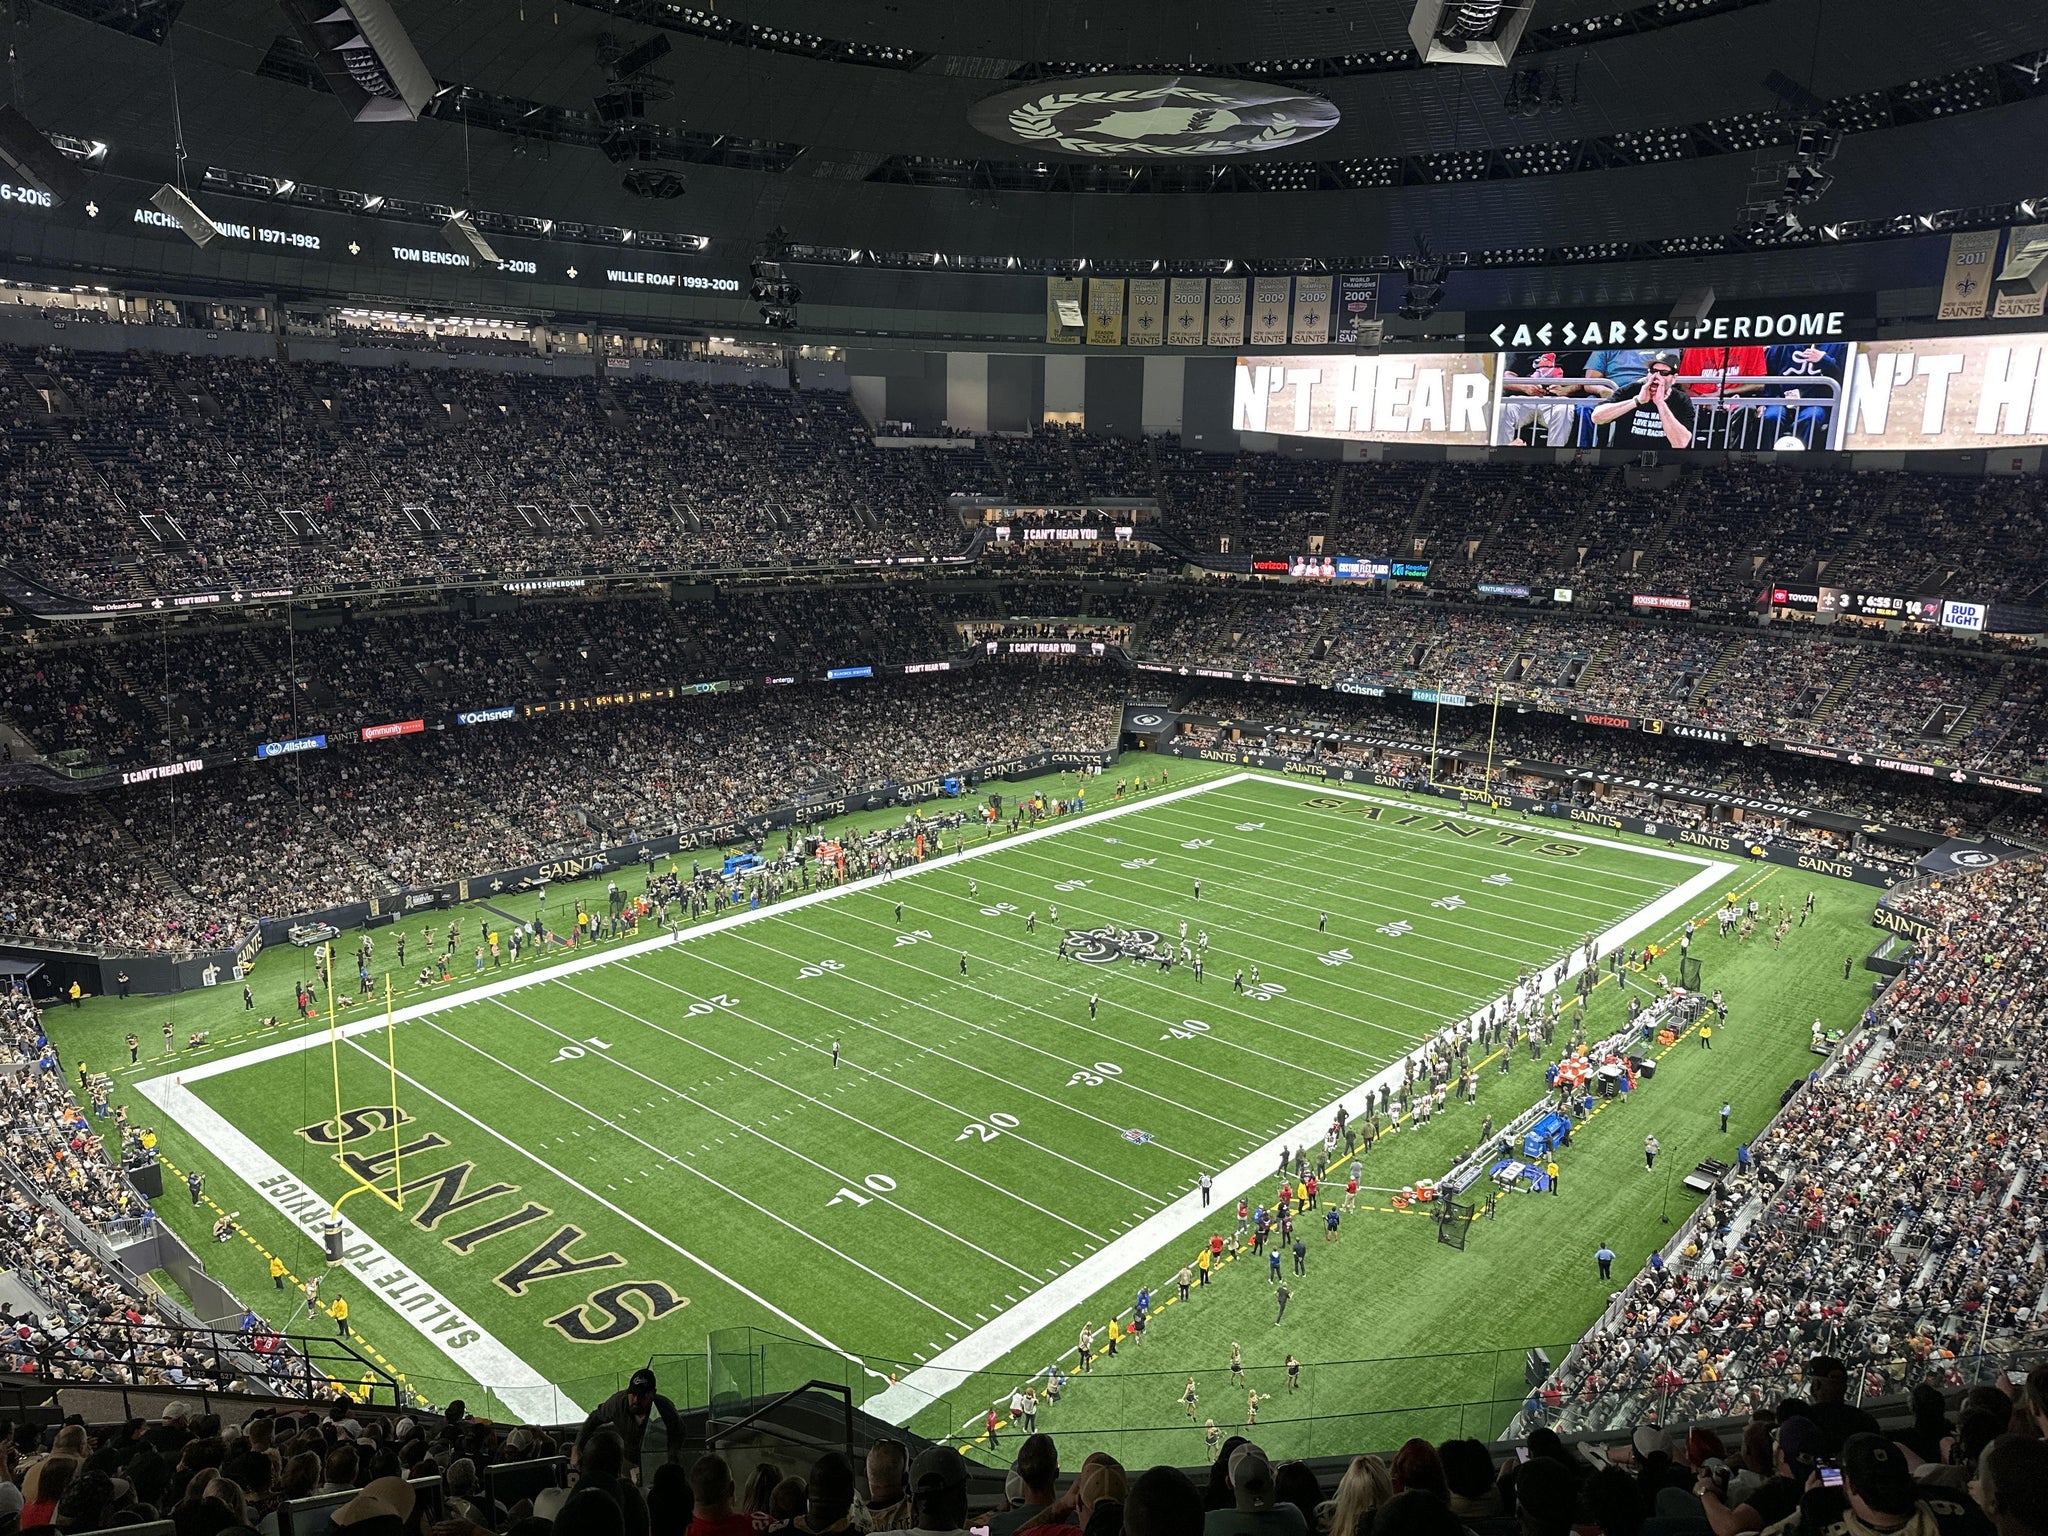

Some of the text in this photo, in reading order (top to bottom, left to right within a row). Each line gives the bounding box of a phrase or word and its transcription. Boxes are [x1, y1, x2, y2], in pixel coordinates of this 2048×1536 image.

[134, 209, 183, 229] ARCHI
[258, 229, 320, 250] 1971-1982
[392, 247, 420, 263] TOM
[422, 251, 470, 267] BENSON
[1957, 252, 1986, 265] 2011
[607, 270, 739, 291] WILLIE ROAF 1993-2001
[1135, 295, 1158, 305] 1991
[1174, 294, 1201, 304] 2000
[1214, 294, 1241, 304] 2006
[1258, 293, 1285, 303] 2009
[1300, 292, 1327, 302] 2009
[1942, 307, 1982, 317] SAINTS
[1997, 304, 2040, 315] SAINTS
[1253, 335, 1284, 344] SAINTS
[1294, 335, 1325, 343] SAINTS
[1489, 319, 1649, 347] CAESARS
[1130, 336, 1160, 345] SAINTS
[1169, 336, 1201, 345] SAINTS
[1210, 336, 1241, 345] SAINTS
[1334, 363, 1490, 432] HEAR
[1023, 529, 1098, 540] I CAN'T HEAR YOU
[1254, 560, 1288, 570] verizon
[435, 576, 464, 584] SAINTS
[497, 572, 525, 580] SAINTS
[302, 584, 334, 594] SAINTS
[370, 580, 401, 589] SAINTS
[1478, 585, 1529, 596] VENTURE GLOBAL
[1633, 595, 1690, 608] ROUSES MARKETS
[1788, 593, 1818, 603] TOYOTA
[1839, 594, 1849, 607] 3
[1866, 595, 1891, 608] 6:55
[92, 604, 105, 612] New
[106, 603, 126, 611] Orleans
[1905, 601, 1922, 615] 14
[1951, 605, 1976, 616] BUD
[1945, 614, 1980, 626] LIGHT
[1015, 643, 1038, 653] CAN'T
[1038, 643, 1059, 653] HEAR
[1060, 643, 1076, 653] YOU
[696, 682, 717, 692] COX
[1308, 677, 1332, 686] SAINTS
[1341, 682, 1384, 697] Ochsner
[1441, 694, 1465, 705] HEALTH
[466, 708, 513, 724] Ochsner
[1536, 704, 1564, 714] SAINTS
[1584, 714, 1629, 728] verizon
[328, 731, 358, 743] SAINTS
[365, 724, 402, 739] Community
[1673, 725, 1727, 742] CAESARS
[1737, 733, 1768, 744] SAINTS
[282, 739, 317, 753] Allstate
[1263, 725, 1463, 757] CAESARS SUPERDOME
[1200, 750, 1237, 762] SAINTS
[1784, 743, 1837, 758] New Orleans Saints
[122, 759, 203, 784] I CAN'T HEAR YOU
[1285, 761, 1323, 775] SAINTS
[1881, 760, 1900, 769] CAN'T
[1978, 776, 2042, 793] New Orleans Saints
[1469, 792, 1512, 807] SAINTS
[1564, 768, 1812, 818] CAESARS SUPERDOME
[1570, 808, 1616, 828] SAINTS
[1299, 798, 1588, 857] SAINTS
[1679, 831, 1730, 850] SAINTS
[1798, 855, 1853, 878] SAINTS
[1431, 895, 1466, 911] 20
[1376, 921, 1413, 937] 30
[901, 929, 933, 946] 40
[1317, 948, 1354, 967] 40
[810, 959, 846, 978] 30
[1246, 983, 1287, 1001] 50
[697, 993, 740, 1016] 20
[1170, 1019, 1211, 1041] 40
[558, 1036, 613, 1061] 10
[1071, 1061, 1123, 1086] 30
[962, 1112, 1020, 1143] 20
[846, 1173, 897, 1208] 10
[293, 1105, 690, 1345] SAINTS
[343, 1243, 386, 1272] TO
[372, 1269, 481, 1349] SALUTE
